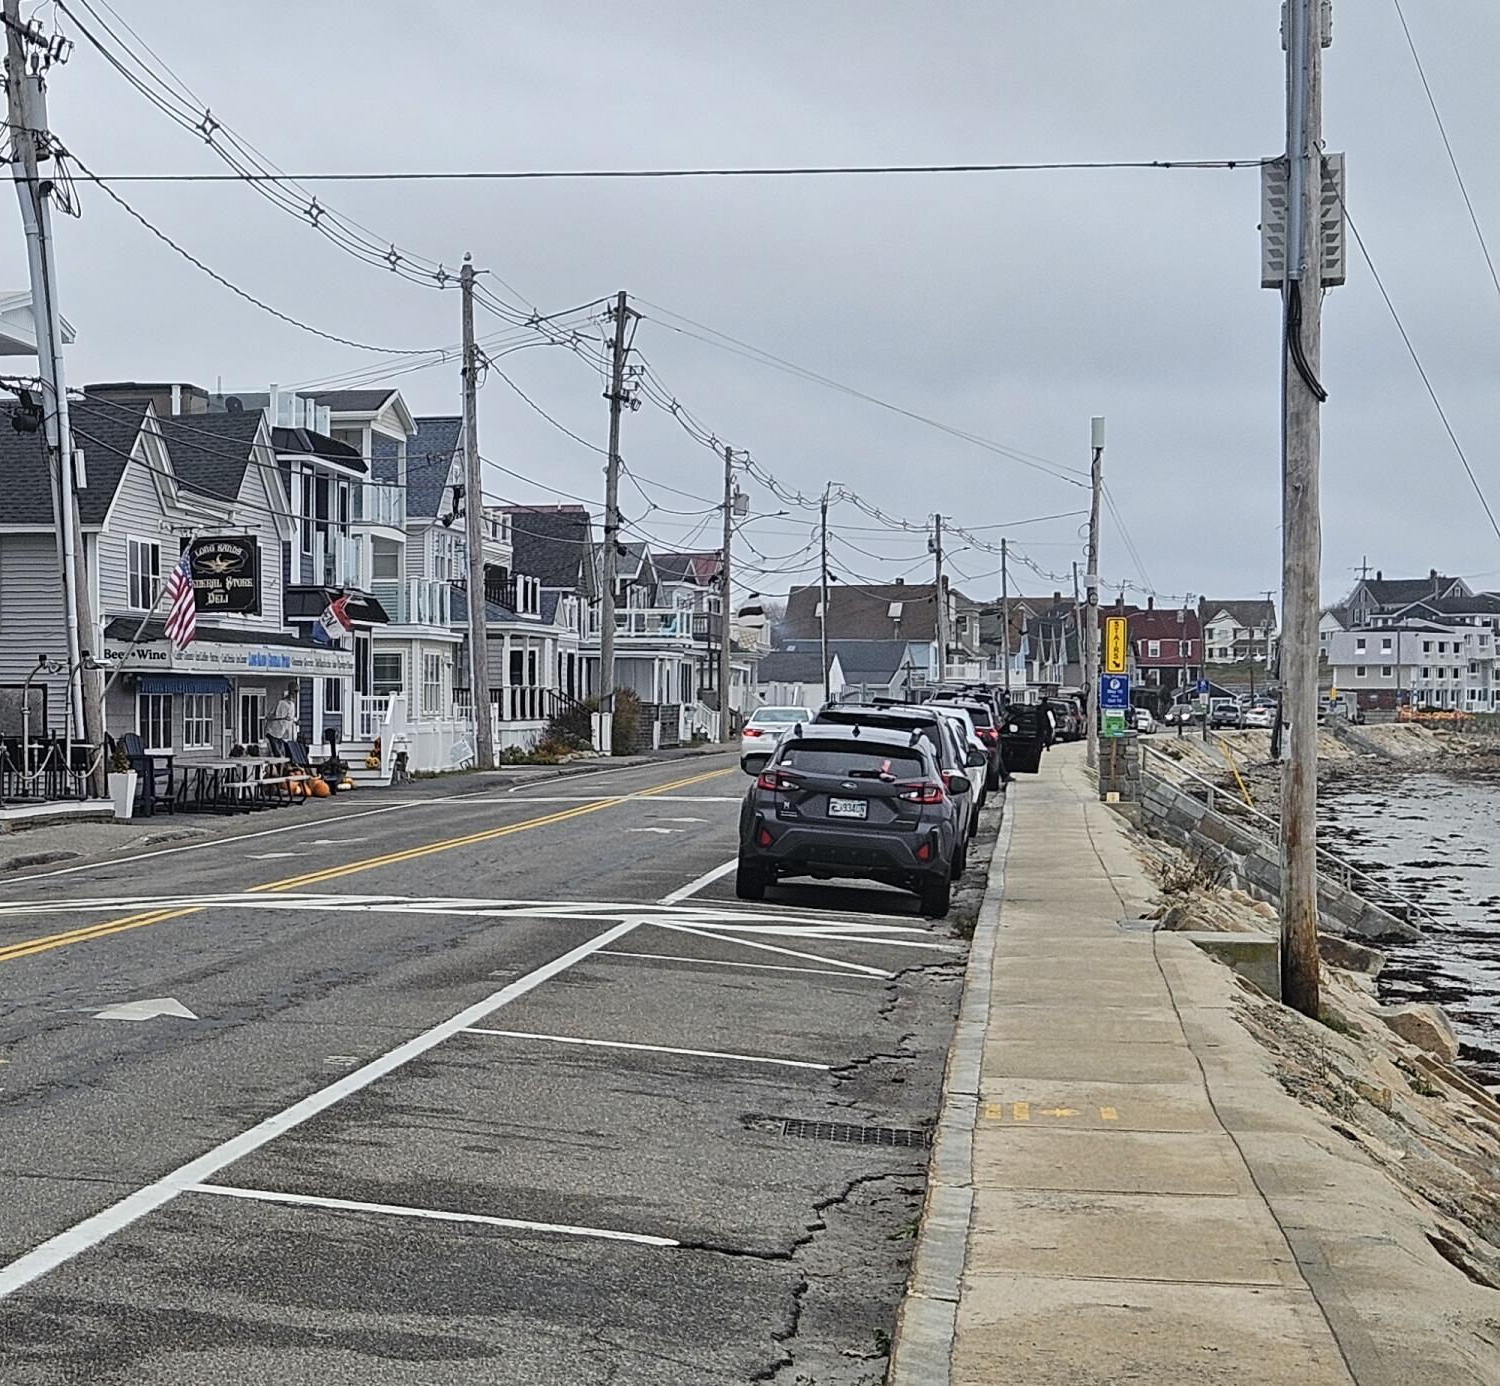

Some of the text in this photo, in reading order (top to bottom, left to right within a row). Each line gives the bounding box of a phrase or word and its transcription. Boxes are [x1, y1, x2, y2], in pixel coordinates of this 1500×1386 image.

[194, 543, 243, 557] LONG SANDS
[192, 576, 253, 590] ENERAL STORE
[205, 592, 229, 605] DELI
[136, 648, 167, 660] Wine
